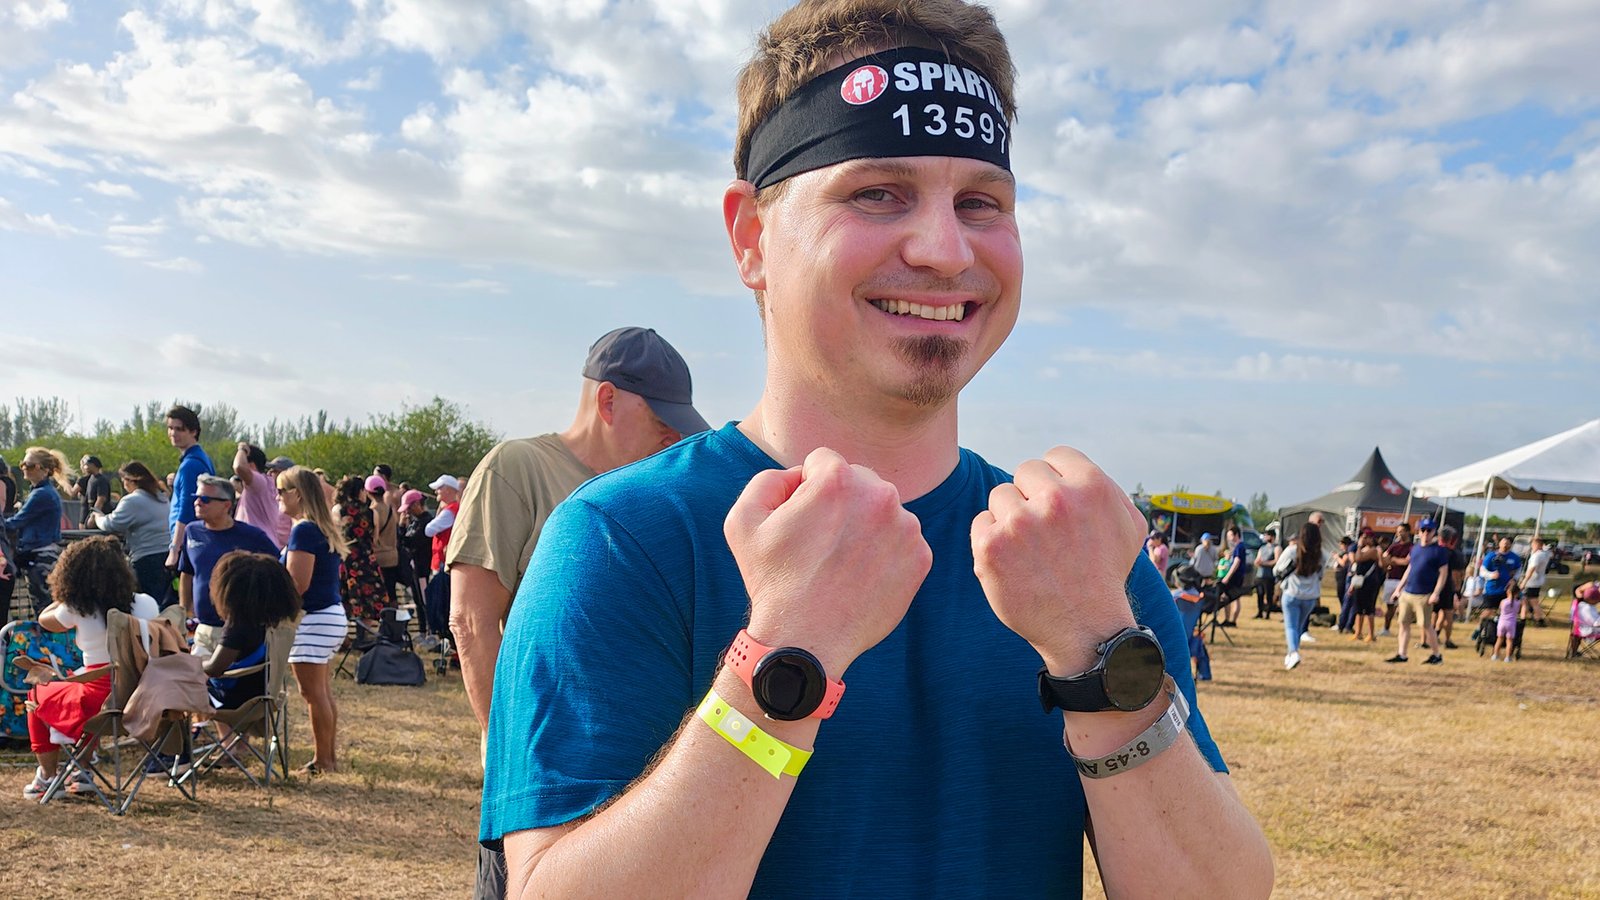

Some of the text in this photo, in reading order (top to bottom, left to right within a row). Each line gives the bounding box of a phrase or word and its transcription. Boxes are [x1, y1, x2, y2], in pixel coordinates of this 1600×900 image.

[893, 61, 1009, 128] SPART
[892, 103, 1006, 154] 13597
[1104, 740, 1150, 771] 8:45
